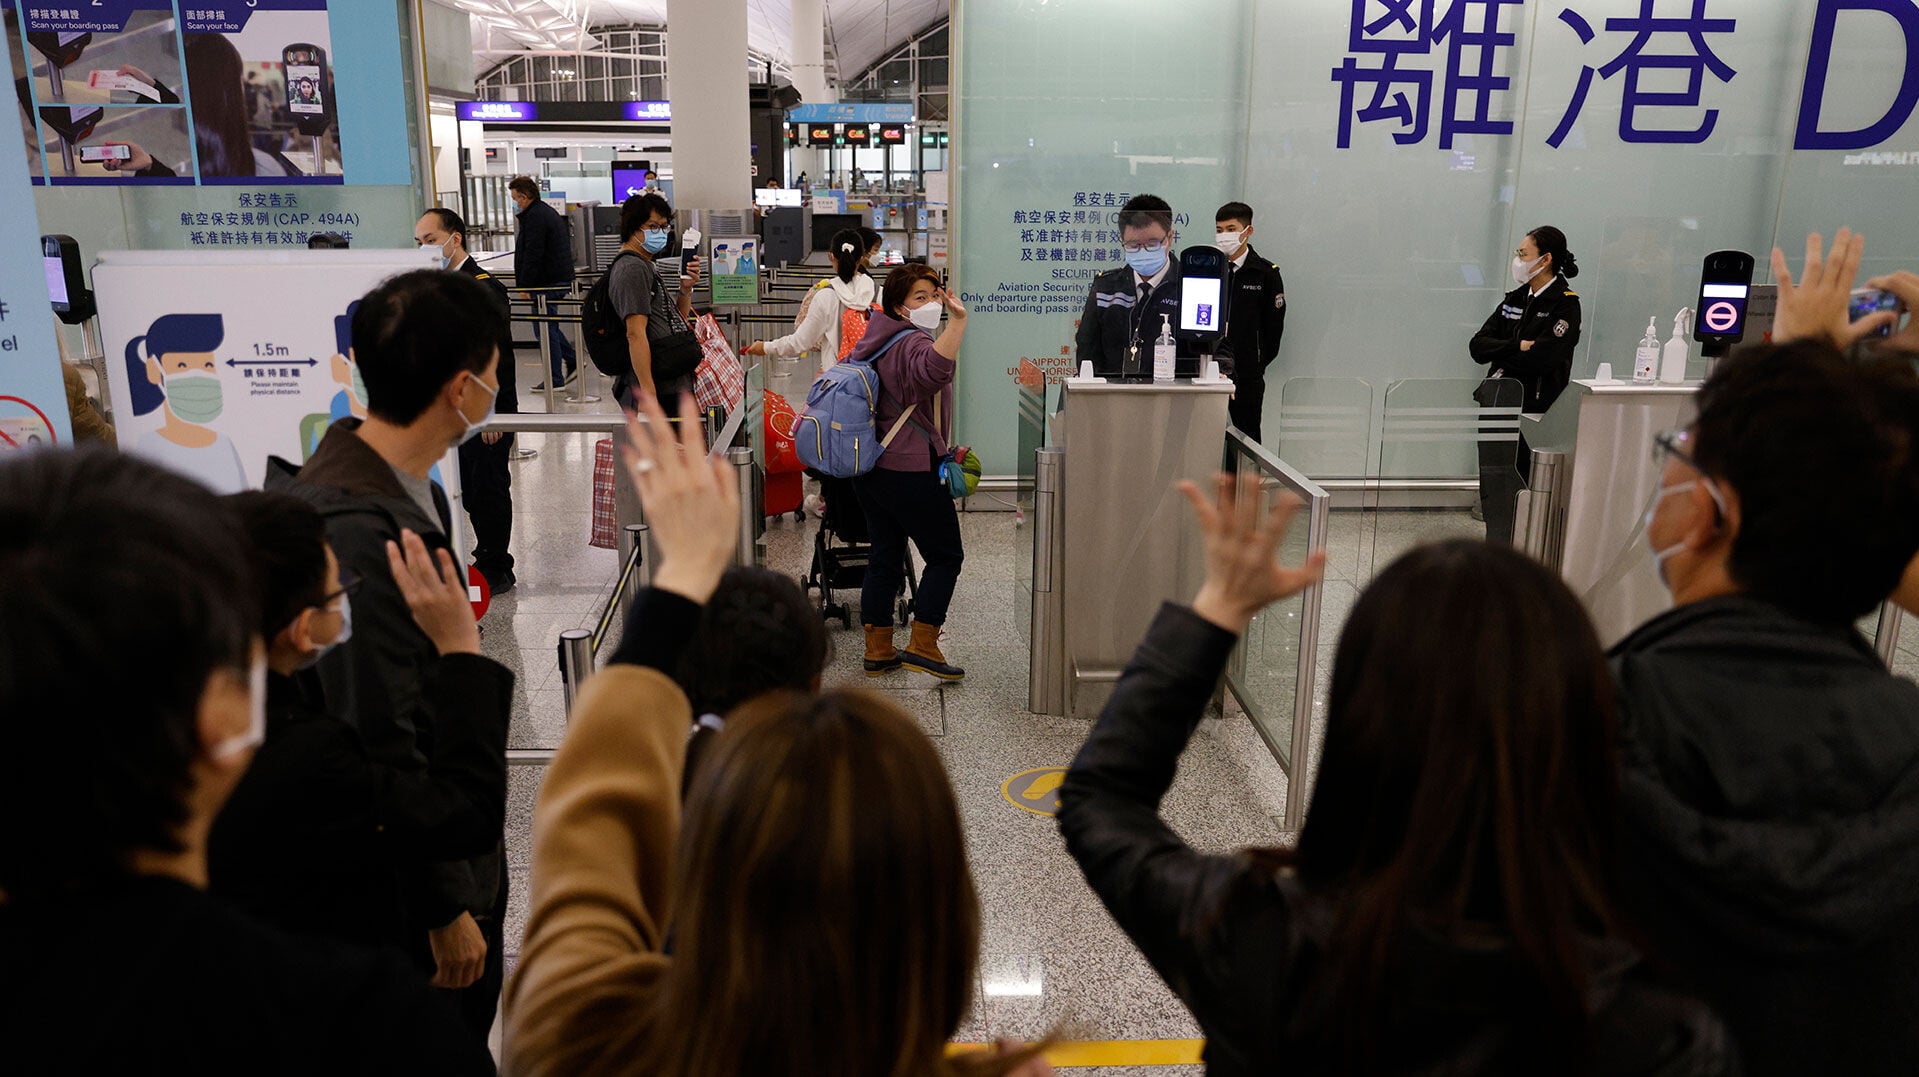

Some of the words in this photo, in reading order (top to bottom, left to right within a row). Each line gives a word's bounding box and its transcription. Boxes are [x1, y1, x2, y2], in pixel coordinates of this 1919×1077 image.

[29, 9, 80, 19] 掃描登機證
[186, 10, 225, 20] 面部掃描
[31, 21, 49, 29] Scan
[69, 22, 101, 31] boarding
[187, 22, 205, 30] Scan
[1331, 0, 1738, 150] 離港
[238, 193, 298, 207] 保安告示
[1073, 192, 1131, 207] 保安告示
[180, 212, 269, 226] 航空保安規例
[318, 212, 360, 227] 494A)
[998, 282, 1040, 291] Aviation
[1043, 282, 1084, 294] Security
[960, 293, 984, 302] Only
[987, 293, 1037, 303] departure
[974, 304, 993, 312] and
[996, 304, 1042, 314] boarding
[1045, 306, 1069, 314] pass
